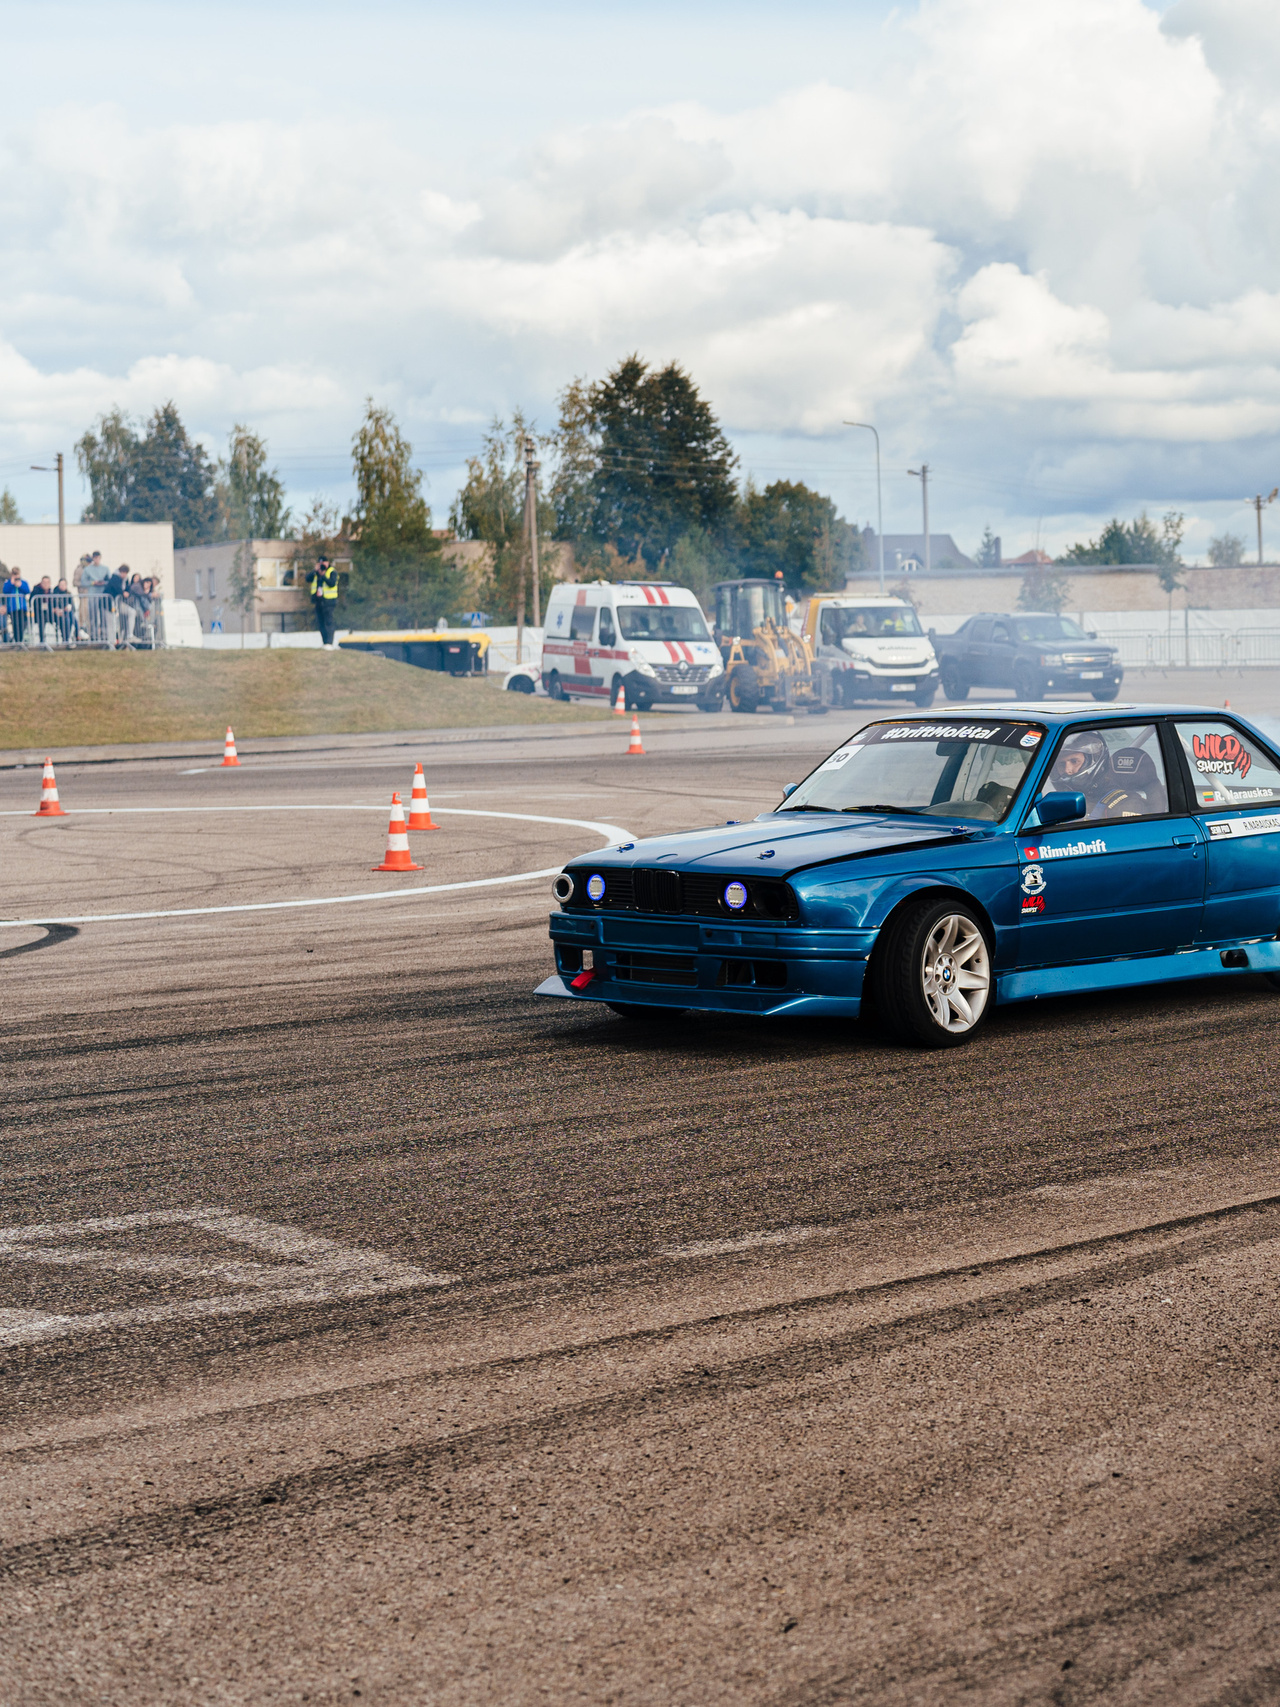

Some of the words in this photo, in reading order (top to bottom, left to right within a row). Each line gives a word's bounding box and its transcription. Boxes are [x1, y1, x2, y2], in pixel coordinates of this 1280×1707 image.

[1192, 733, 1241, 761] WILD
[1117, 758, 1134, 767] OMP
[1038, 838, 1107, 859] RimvisDrift
